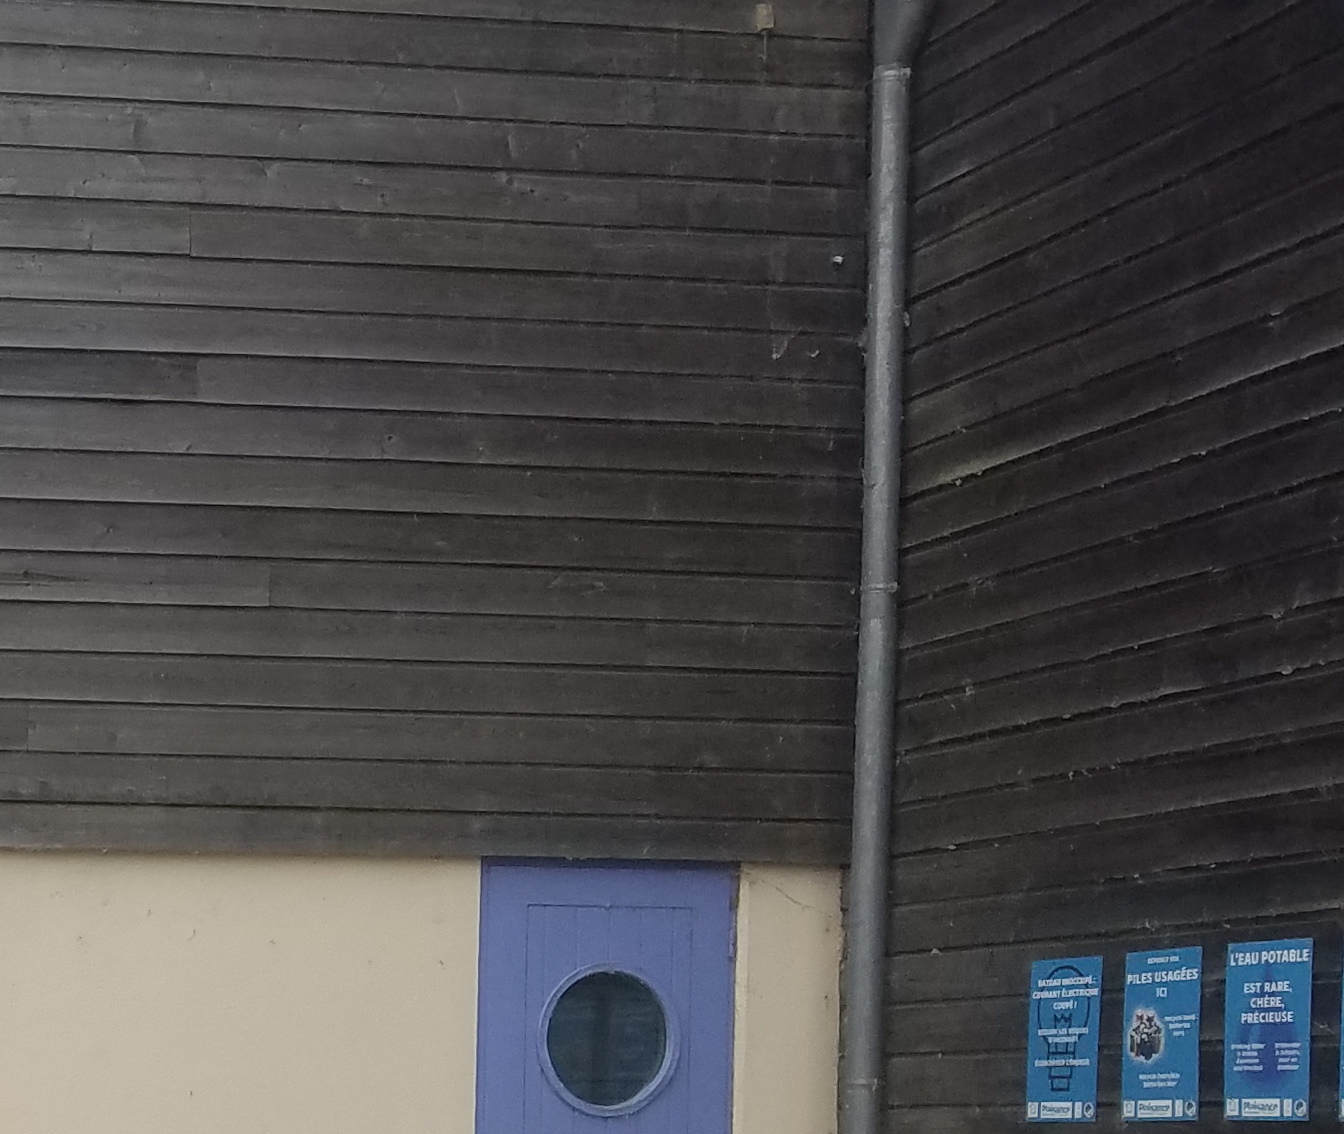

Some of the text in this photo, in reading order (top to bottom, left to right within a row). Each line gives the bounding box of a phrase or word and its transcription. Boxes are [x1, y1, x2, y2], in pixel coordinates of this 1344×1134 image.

[1230, 949, 1310, 966] L'EAU POTABLE
[1127, 967, 1199, 985] PILES USAGÉES
[1156, 987, 1167, 998] ICI
[1244, 980, 1293, 993] EST RARE,
[1241, 1010, 1294, 1024] PRÉCIEUSE
